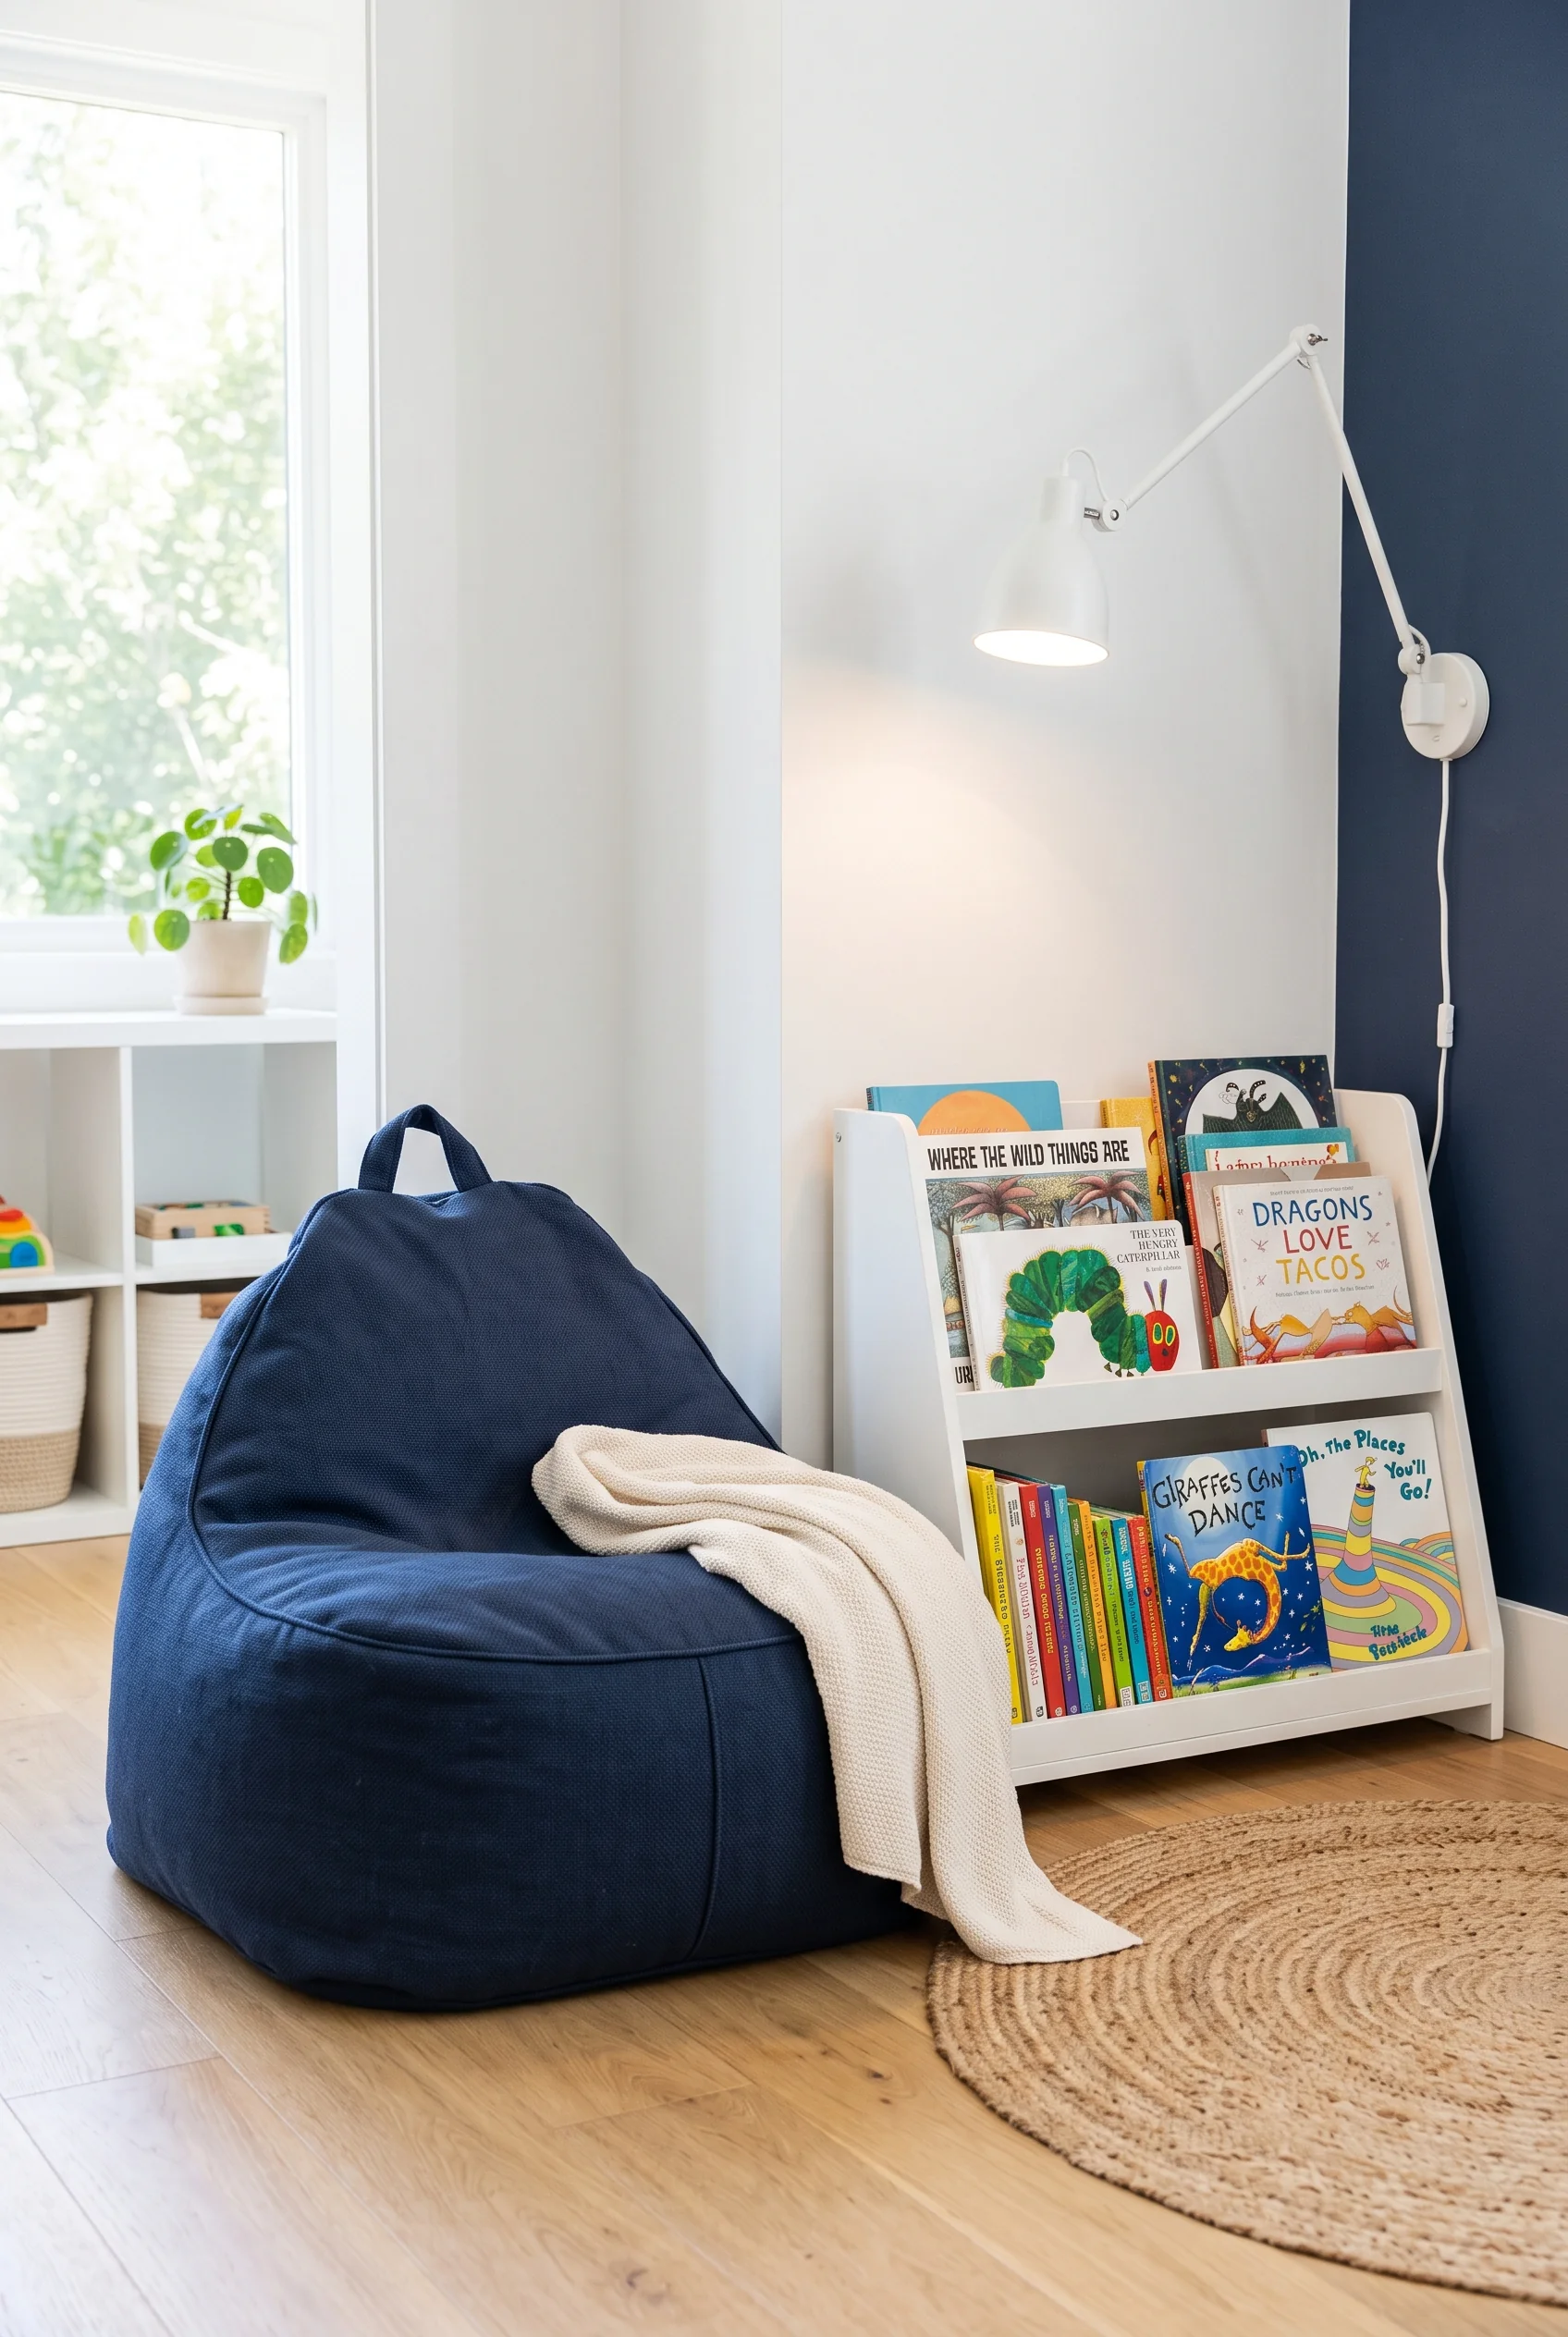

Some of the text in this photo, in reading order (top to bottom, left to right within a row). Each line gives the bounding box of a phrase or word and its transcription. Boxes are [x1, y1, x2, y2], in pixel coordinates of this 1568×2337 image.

[927, 1140, 1130, 1171] WHERE THE WILD THINGS ARE
[1252, 1194, 1373, 1227] DRAGONS
[1130, 1229, 1151, 1240] THE
[1282, 1225, 1353, 1254] LOVE
[1275, 1253, 1366, 1285] TACOS
[1325, 1438, 1352, 1455] The
[1354, 1429, 1405, 1456] Places
[1384, 1459, 1426, 1479] You'll
[1152, 1472, 1243, 1509] GIRAFFES
[1247, 1462, 1297, 1493] CAN'T
[1400, 1478, 1432, 1500] Go!
[1188, 1499, 1266, 1537] DANCE
